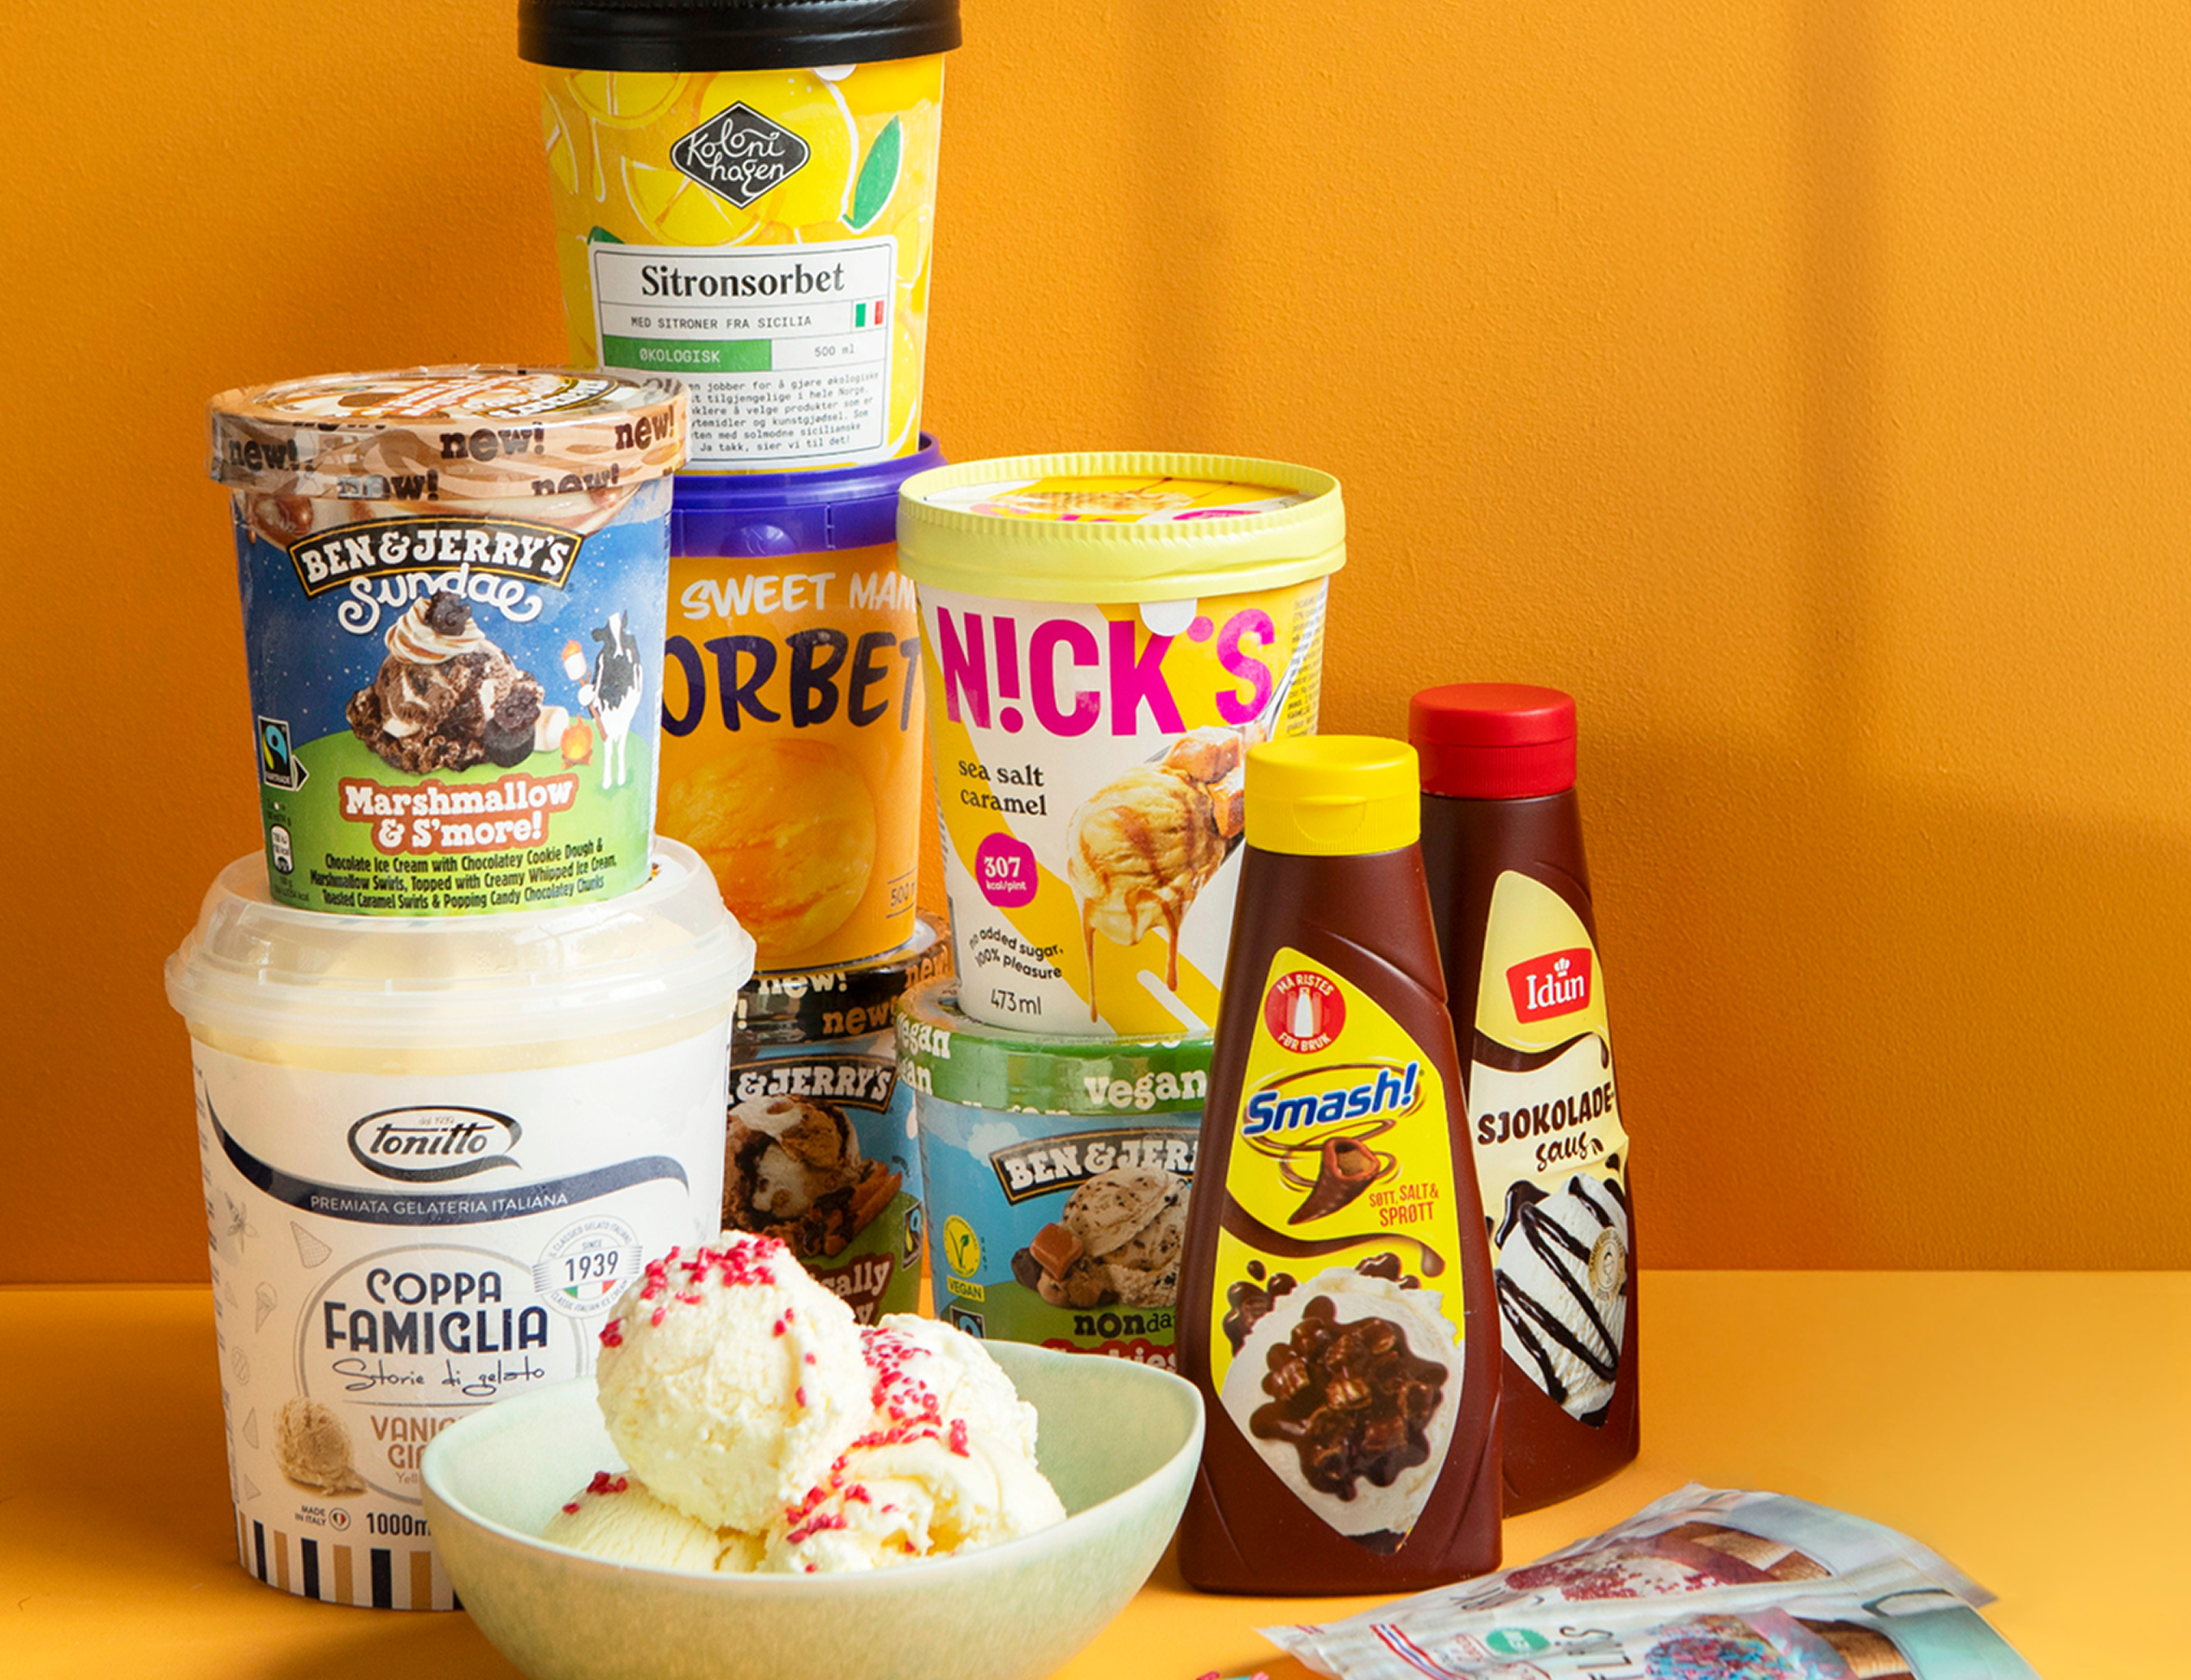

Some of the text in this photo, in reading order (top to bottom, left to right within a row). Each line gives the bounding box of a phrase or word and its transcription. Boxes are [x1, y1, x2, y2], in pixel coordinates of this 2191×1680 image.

[687, 118, 785, 166] Koloni
[710, 151, 785, 197] hagen
[641, 262, 845, 298] Sitronsorbet
[631, 315, 812, 330] MED SITRONER FRA SICILIA
[639, 347, 721, 364] ØKOLOGISK
[814, 343, 855, 358] 500 ml
[707, 381, 746, 393] jobber
[752, 381, 772, 390] for
[777, 379, 786, 390] å
[790, 379, 822, 390] gjøre
[707, 392, 792, 405] tilgjengelige
[809, 388, 833, 399] hele
[733, 405, 740, 416] å
[746, 404, 778, 416] velge
[785, 402, 838, 415] produkter
[752, 419, 766, 429] og
[439, 420, 545, 463] new!
[614, 403, 675, 450] new!
[718, 430, 737, 439] med
[743, 429, 794, 439] solmodne
[800, 422, 860, 437] sicilianske
[699, 442, 712, 452] Ja
[756, 441, 782, 451] sier
[787, 439, 799, 449] vi
[806, 437, 823, 448] til
[338, 562, 544, 635] Sundae
[680, 573, 837, 620] SWEET
[958, 760, 1045, 787] sea salt
[345, 781, 574, 816] Marshmallow
[960, 789, 1048, 816] caramel
[377, 809, 542, 848] & S'more!
[325, 853, 372, 872] Chocolate
[374, 857, 390, 872] Ice
[393, 857, 429, 873] Cream
[432, 857, 458, 872] with
[461, 854, 523, 872] Chocolatey
[527, 846, 562, 865] Cookie
[565, 839, 594, 860] Dough
[984, 855, 1022, 878] 307
[310, 868, 370, 890] Marshmallow
[372, 875, 408, 892] Swirls,
[411, 875, 452, 893] Topped
[455, 873, 481, 890] with
[484, 871, 526, 889] Creamy
[528, 862, 574, 884] Whipped
[575, 859, 589, 877] Ice
[985, 879, 1027, 893] kcal/pint
[357, 892, 396, 908] Caramel
[398, 894, 428, 909] Swirls
[432, 894, 441, 908] &
[443, 891, 487, 909] Popping
[489, 889, 521, 906] Candy
[523, 881, 575, 902] Chocolatey
[979, 925, 1018, 950] added
[975, 947, 1062, 980] 100% pleasure
[1295, 973, 1335, 997] RISTES
[1526, 973, 1586, 1010] Idun
[1300, 1032, 1332, 1052] BRUK
[1083, 1069, 1207, 1110] vegan
[1242, 1062, 1418, 1135] Smash!
[369, 1122, 495, 1155] tonitto
[1535, 1131, 1588, 1172] saus
[1117, 1139, 1199, 1171] JER
[310, 1192, 569, 1215] PREMIATA GELATERIA ITALIANA
[1379, 1200, 1435, 1227] SPRØTT
[581, 1238, 603, 1251] SINCE
[565, 1250, 619, 1282] 1939
[366, 1267, 502, 1307] COPPA
[949, 1278, 983, 1299] VEGAN
[323, 1300, 549, 1355] FAMIGLIA
[331, 1355, 546, 1397] Storie di gelato
[301, 1505, 325, 1517] MADE
